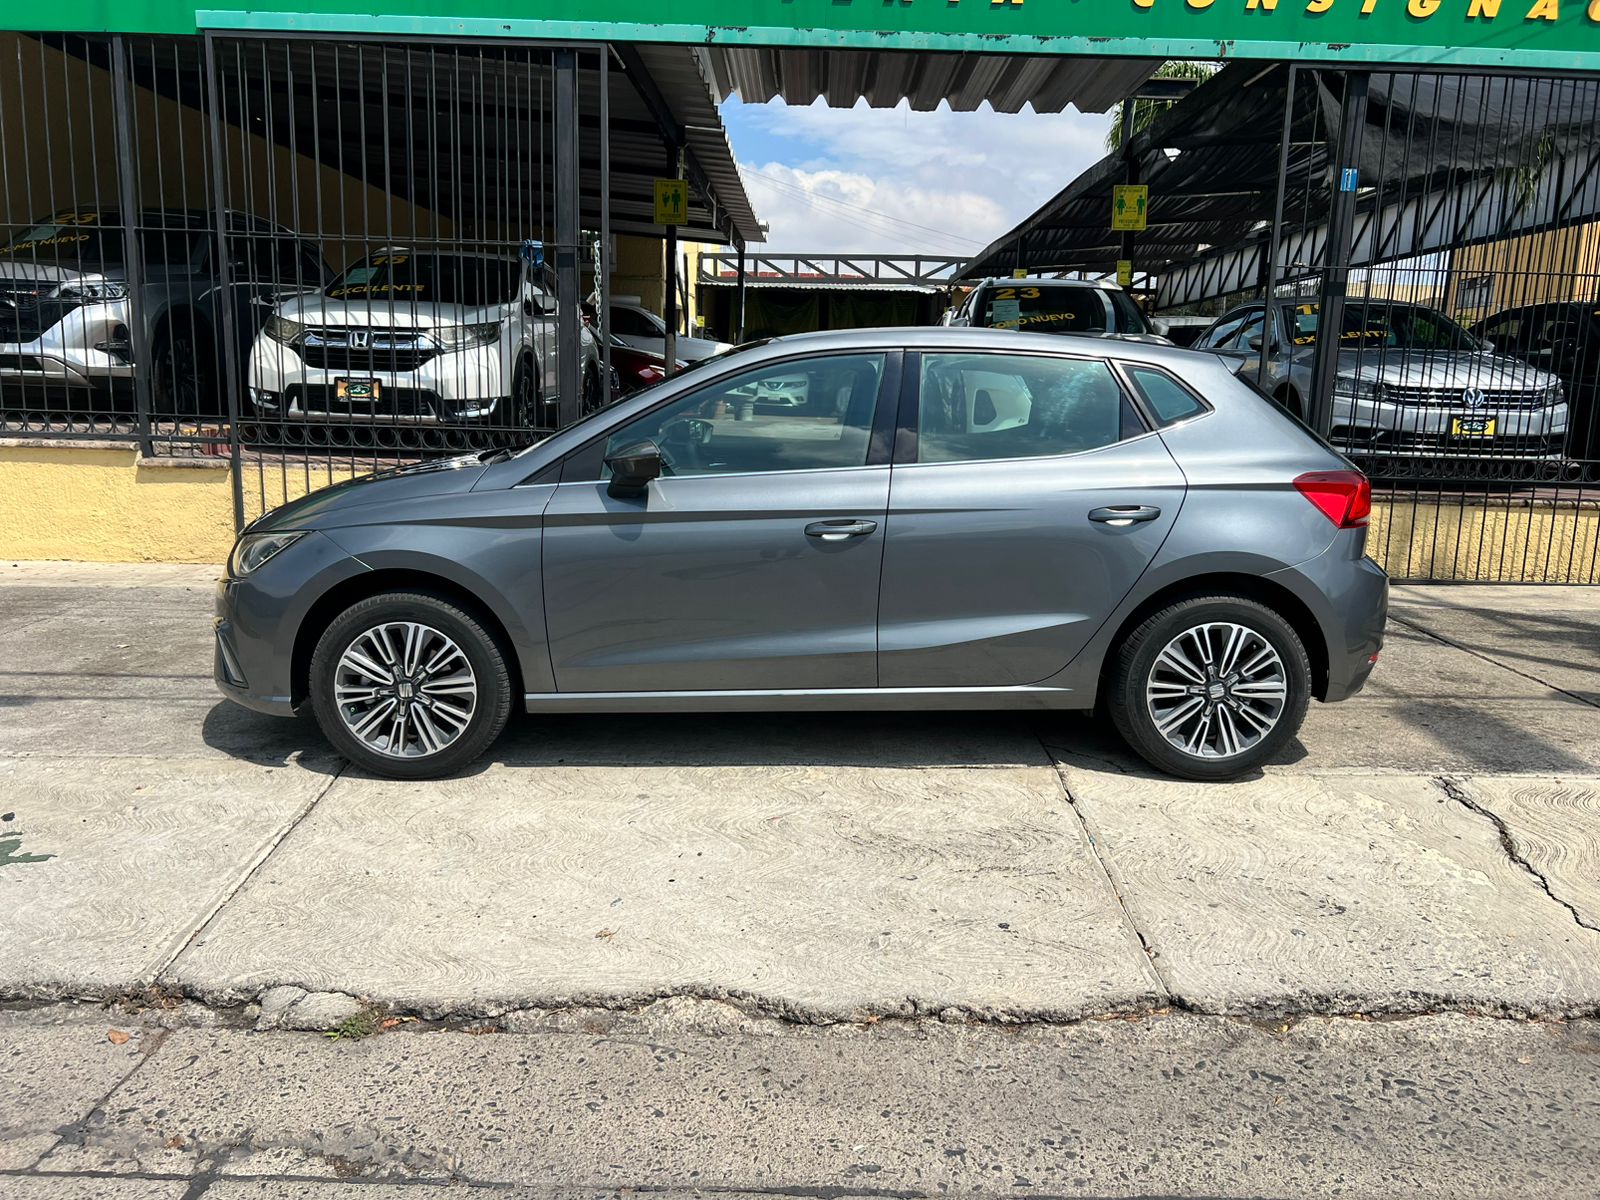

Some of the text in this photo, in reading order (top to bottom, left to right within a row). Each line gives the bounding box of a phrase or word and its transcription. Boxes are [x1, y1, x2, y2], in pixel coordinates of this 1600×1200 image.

[49, 213, 98, 225] 23
[39, 234, 90, 246] NUEVO
[995, 288, 1040, 299] 23
[1030, 313, 1075, 324] NUEVO
